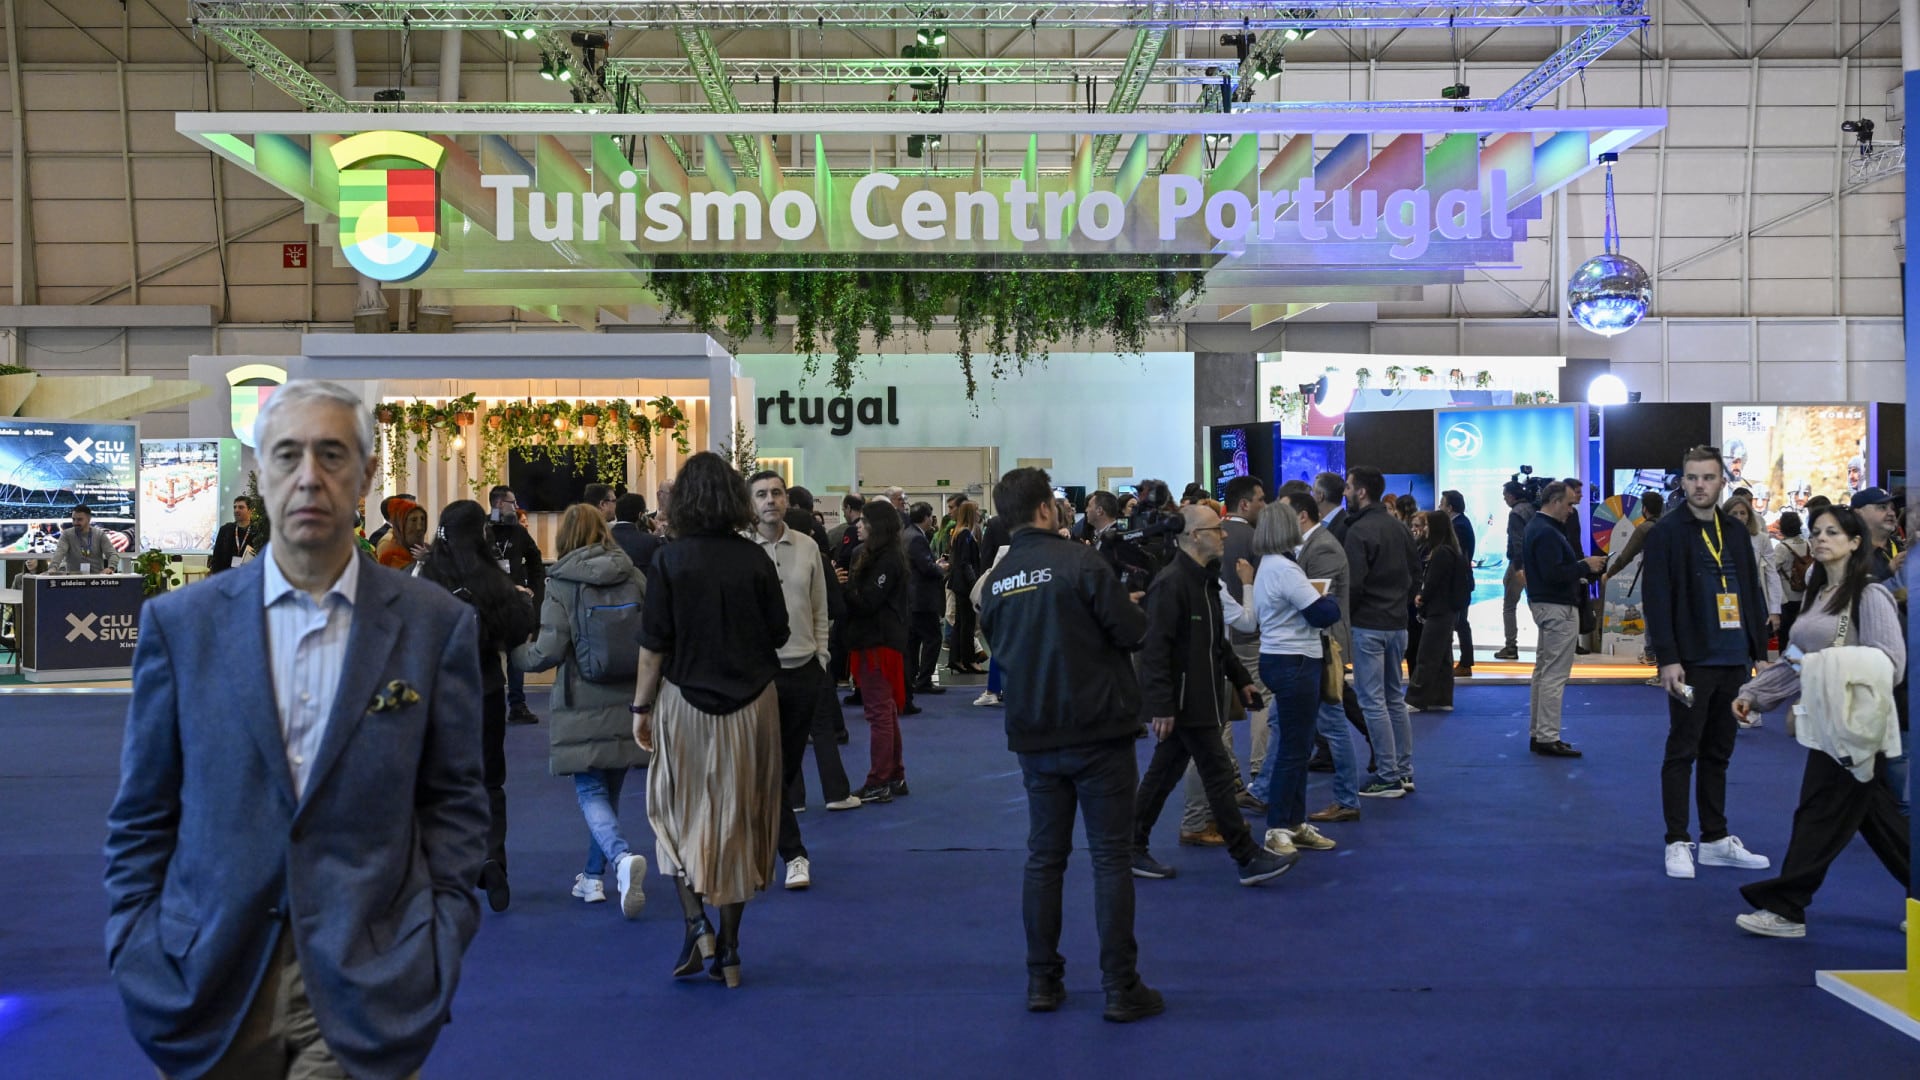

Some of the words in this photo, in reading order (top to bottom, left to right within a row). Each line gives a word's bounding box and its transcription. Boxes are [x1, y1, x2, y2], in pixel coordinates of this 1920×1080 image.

[481, 171, 818, 242] Turismo
[850, 171, 1126, 242] Centro
[1158, 168, 1513, 261] Portugal
[757, 386, 900, 436] rtugal
[100, 628, 138, 641] SIVE
[1838, 615, 1848, 638] TOUS
